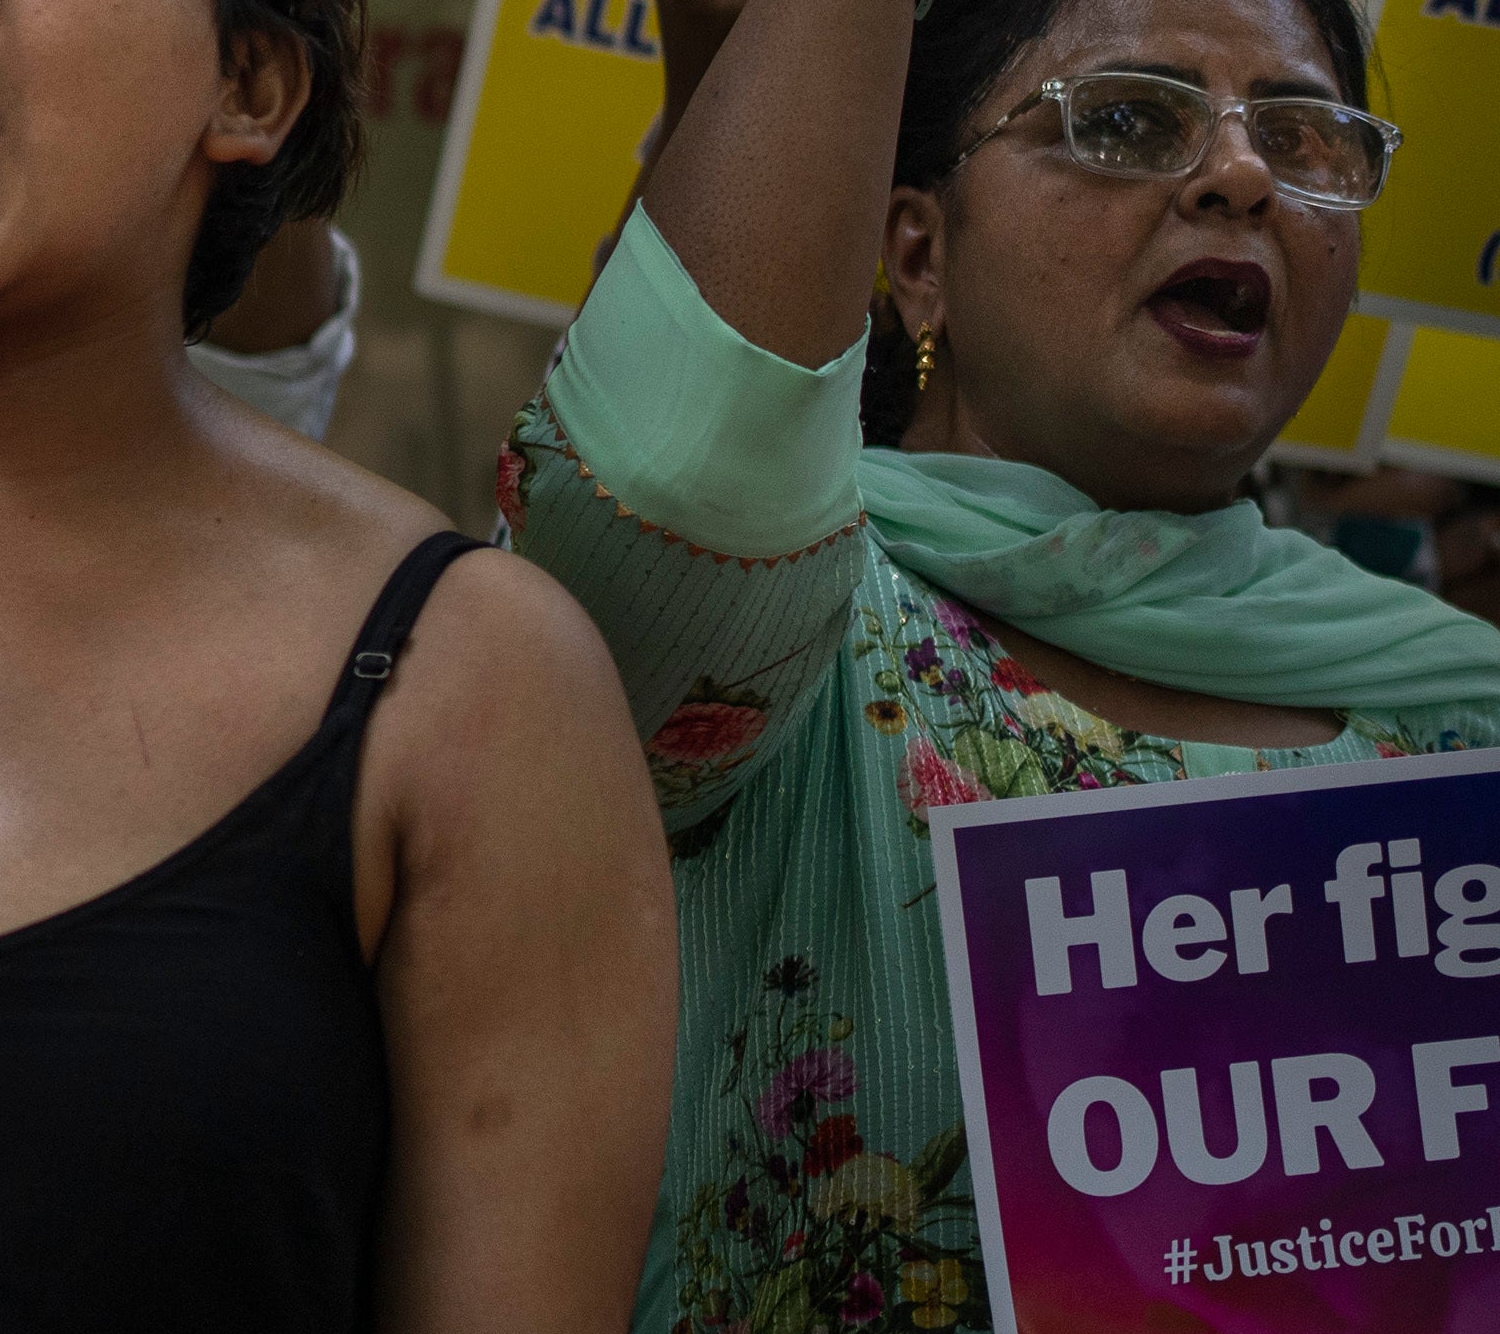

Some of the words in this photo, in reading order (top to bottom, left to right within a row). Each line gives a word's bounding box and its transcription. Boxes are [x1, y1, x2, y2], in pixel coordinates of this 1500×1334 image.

[1024, 868, 1294, 996] Her
[1047, 1052, 1385, 1197] OUR
[1163, 1206, 1500, 1285] #JusticeFor
